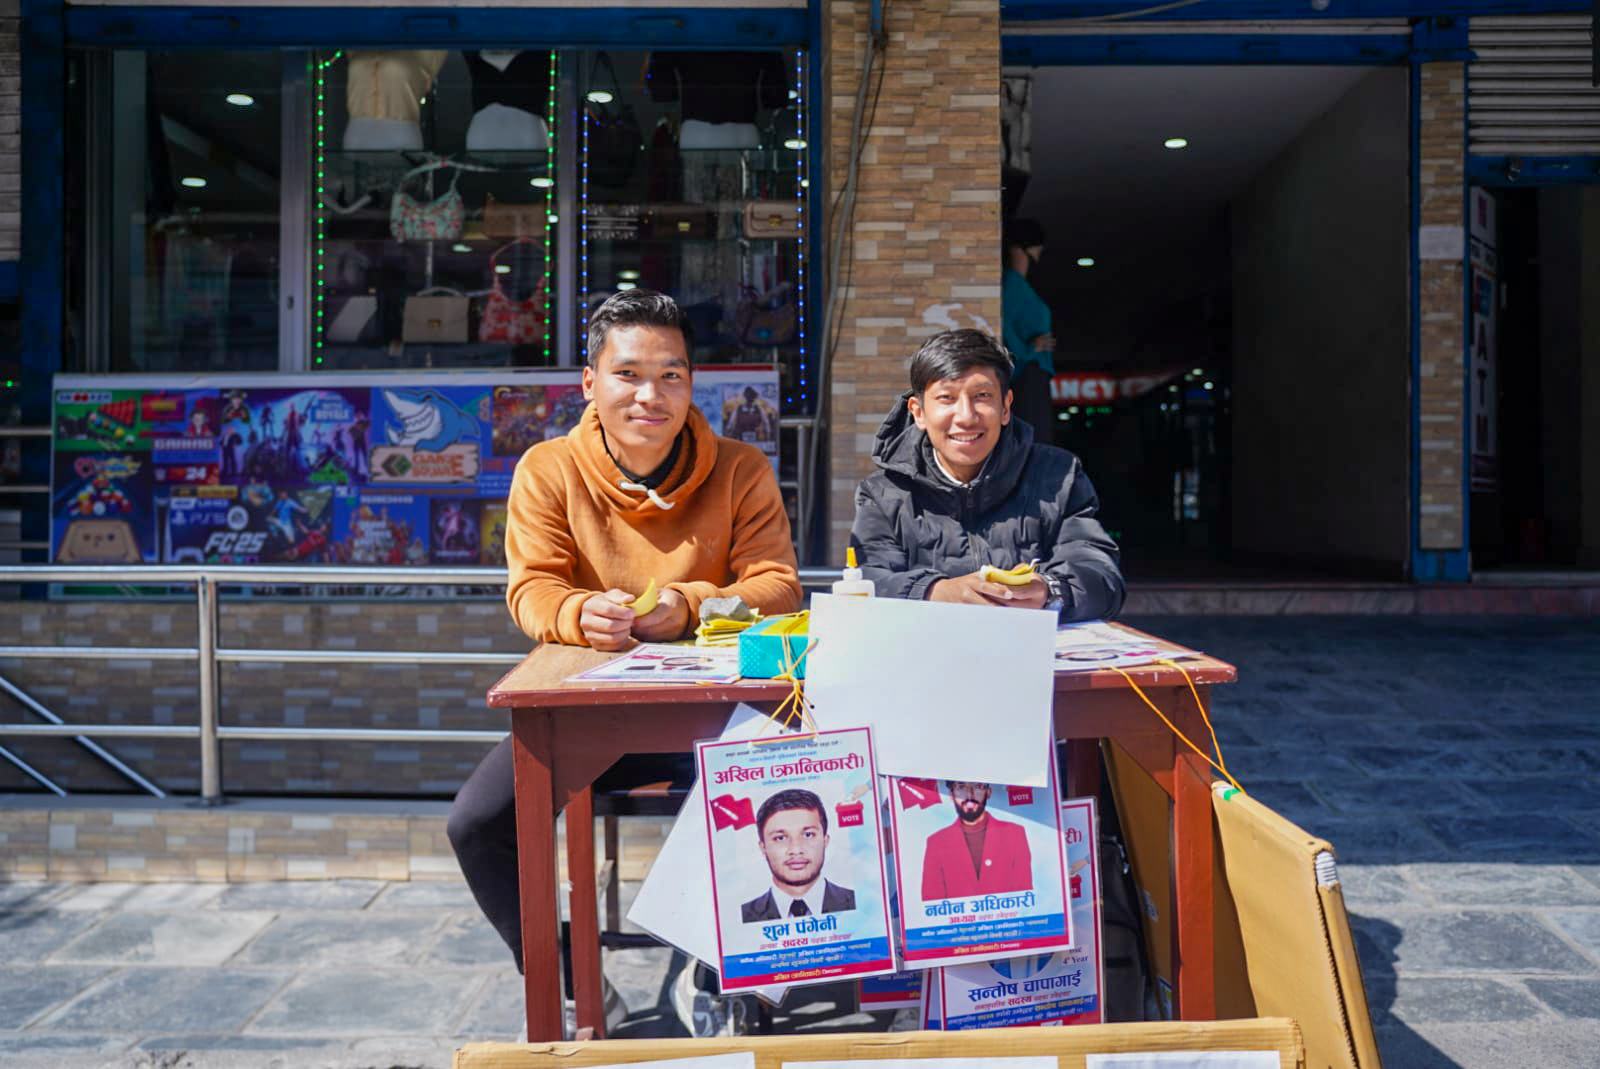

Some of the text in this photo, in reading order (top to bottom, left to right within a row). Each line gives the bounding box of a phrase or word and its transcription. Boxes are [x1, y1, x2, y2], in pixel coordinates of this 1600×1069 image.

[714, 766, 765, 784] अखिल
[770, 752, 865, 779] (क्रान्तिकारी)
[1012, 793, 1030, 802] VOTE
[842, 814, 860, 823] VOTE
[925, 900, 965, 917] नवीन
[970, 891, 1035, 913] अधिकारी
[762, 923, 789, 941] शुभ
[781, 937, 809, 949] सदस्य
[1071, 955, 1089, 965] Year
[968, 981, 1018, 1002] सन्तोष
[1007, 995, 1033, 1007] सदस्य
